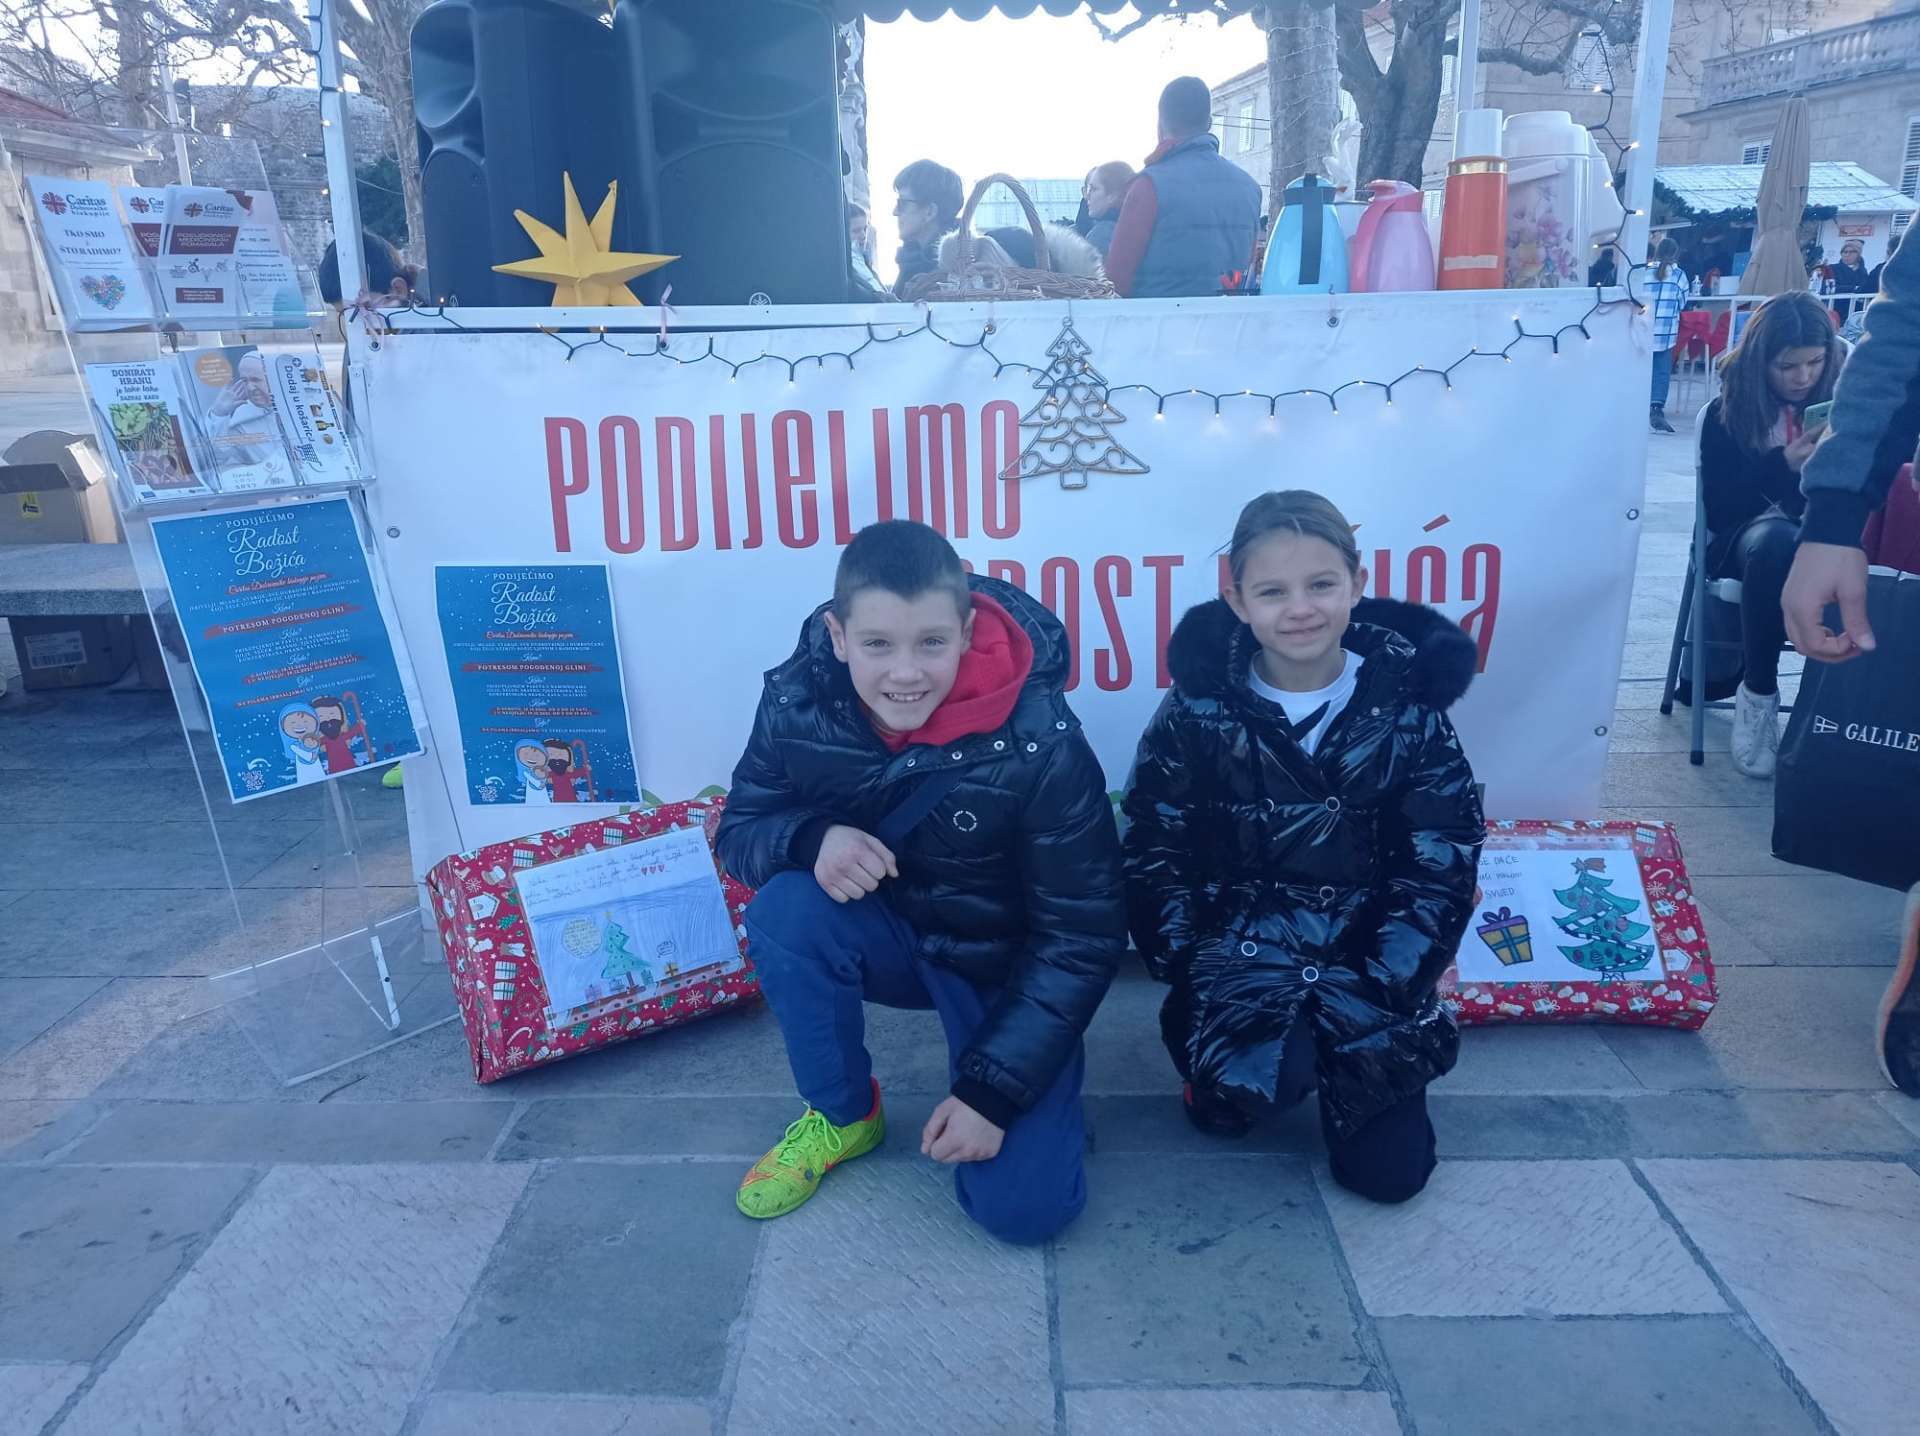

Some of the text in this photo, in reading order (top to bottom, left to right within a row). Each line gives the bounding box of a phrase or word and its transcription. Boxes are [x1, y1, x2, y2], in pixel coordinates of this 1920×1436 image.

[111, 368, 155, 377] DONIRATI
[119, 377, 152, 385] HRANU
[285, 365, 298, 395] Dodaj
[225, 512, 295, 528] PODIJELIMO
[227, 525, 300, 554] Radost
[234, 549, 306, 578] Božića
[493, 571, 554, 581] PODIJELIMO
[491, 582, 556, 604] Radost
[222, 619, 269, 633] POTRESOM
[321, 606, 345, 616] GLINI
[494, 602, 557, 630] Božića
[1845, 722, 1920, 752] GALILE
